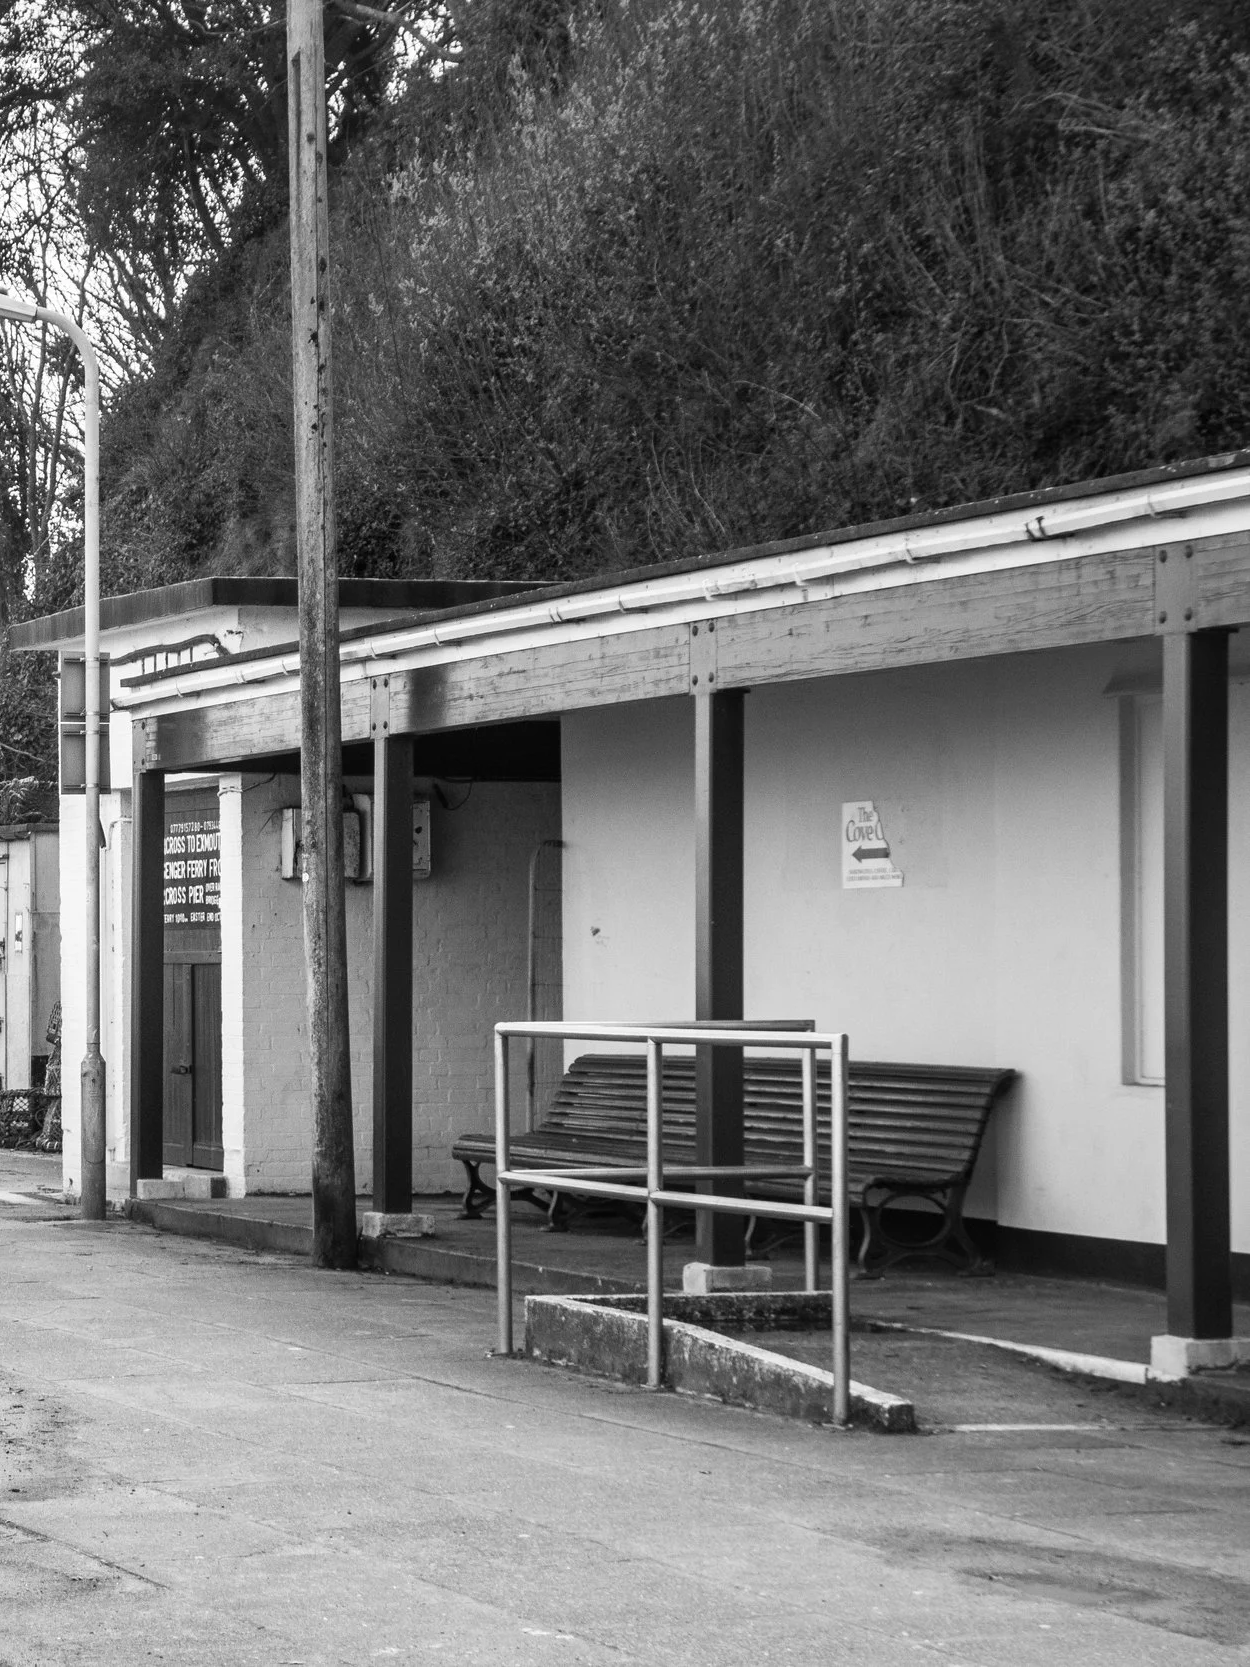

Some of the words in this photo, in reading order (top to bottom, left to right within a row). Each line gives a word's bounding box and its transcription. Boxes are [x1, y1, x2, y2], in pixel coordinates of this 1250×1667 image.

[857, 807, 873, 822] The
[846, 820, 873, 842] Cove
[187, 835, 195, 853] TO
[196, 833, 221, 852] EXMOUT
[187, 859, 207, 879] FERRY
[209, 858, 221, 877] FRO
[188, 885, 204, 904] PIER
